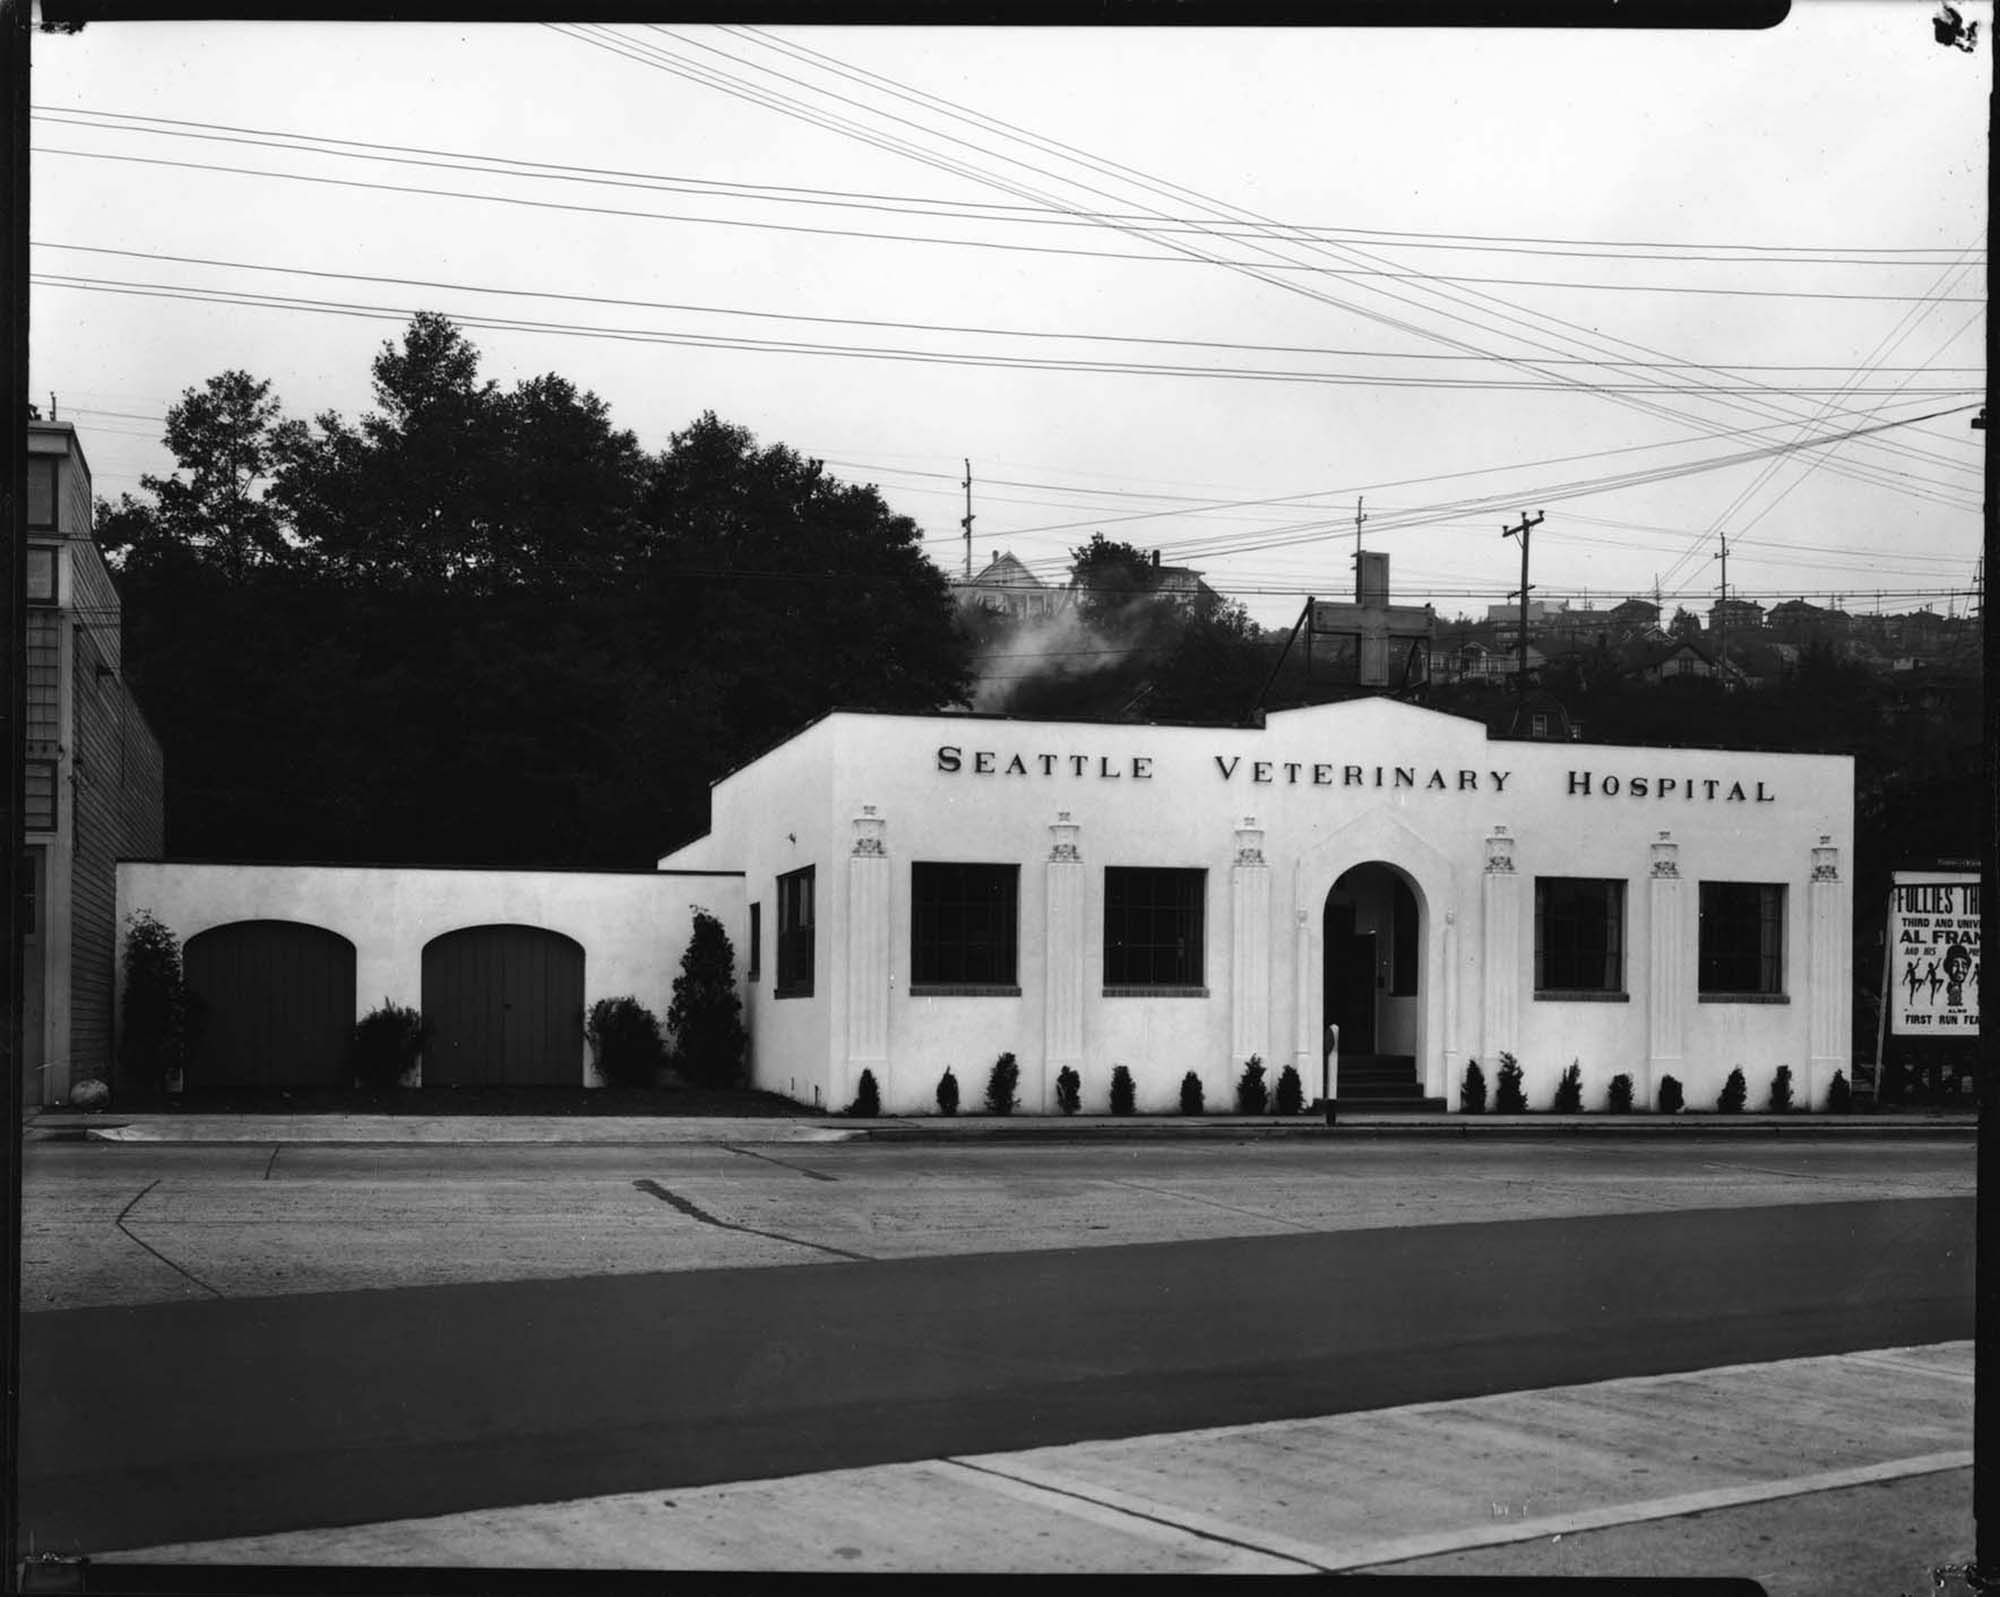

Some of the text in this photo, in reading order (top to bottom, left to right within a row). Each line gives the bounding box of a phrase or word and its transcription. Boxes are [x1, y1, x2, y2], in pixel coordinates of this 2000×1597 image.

[1902, 918, 1930, 928] THIRD
[1934, 919, 1953, 928] AND
[1900, 930, 1927, 944] AL
[1905, 1015, 1932, 1025] FIRST
[1939, 1015, 1959, 1025] RUN
